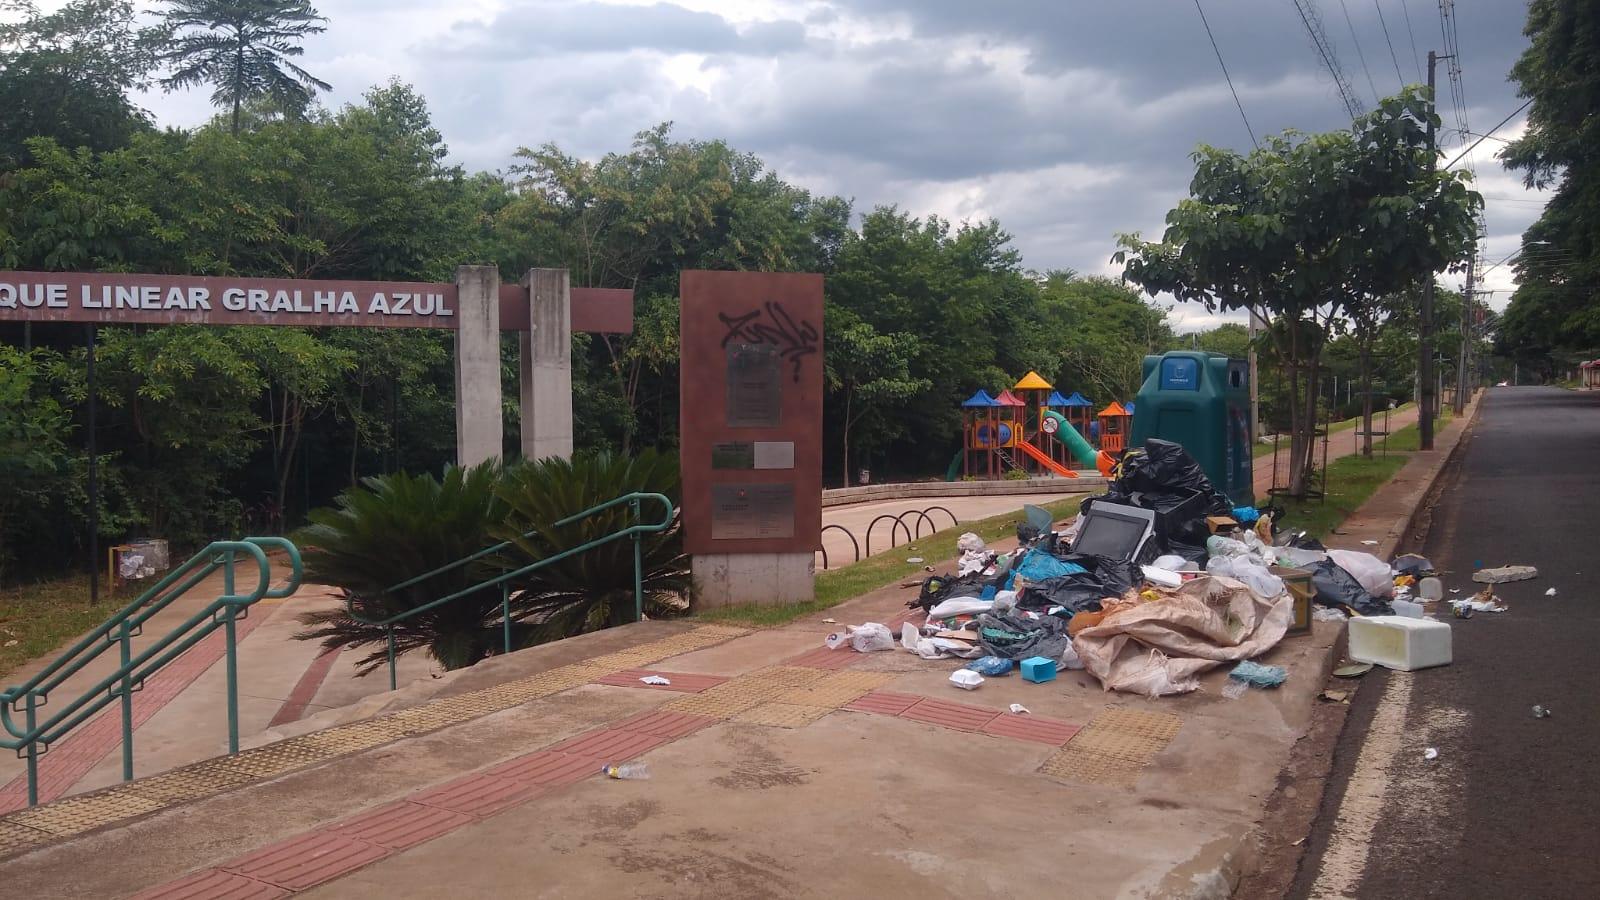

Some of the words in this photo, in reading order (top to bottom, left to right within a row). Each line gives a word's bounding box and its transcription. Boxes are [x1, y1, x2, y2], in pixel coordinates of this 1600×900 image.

[0, 283, 68, 308] QUE
[81, 284, 212, 310] LINEAR
[222, 288, 361, 313] GRALHA
[367, 292, 454, 316] AZUL
